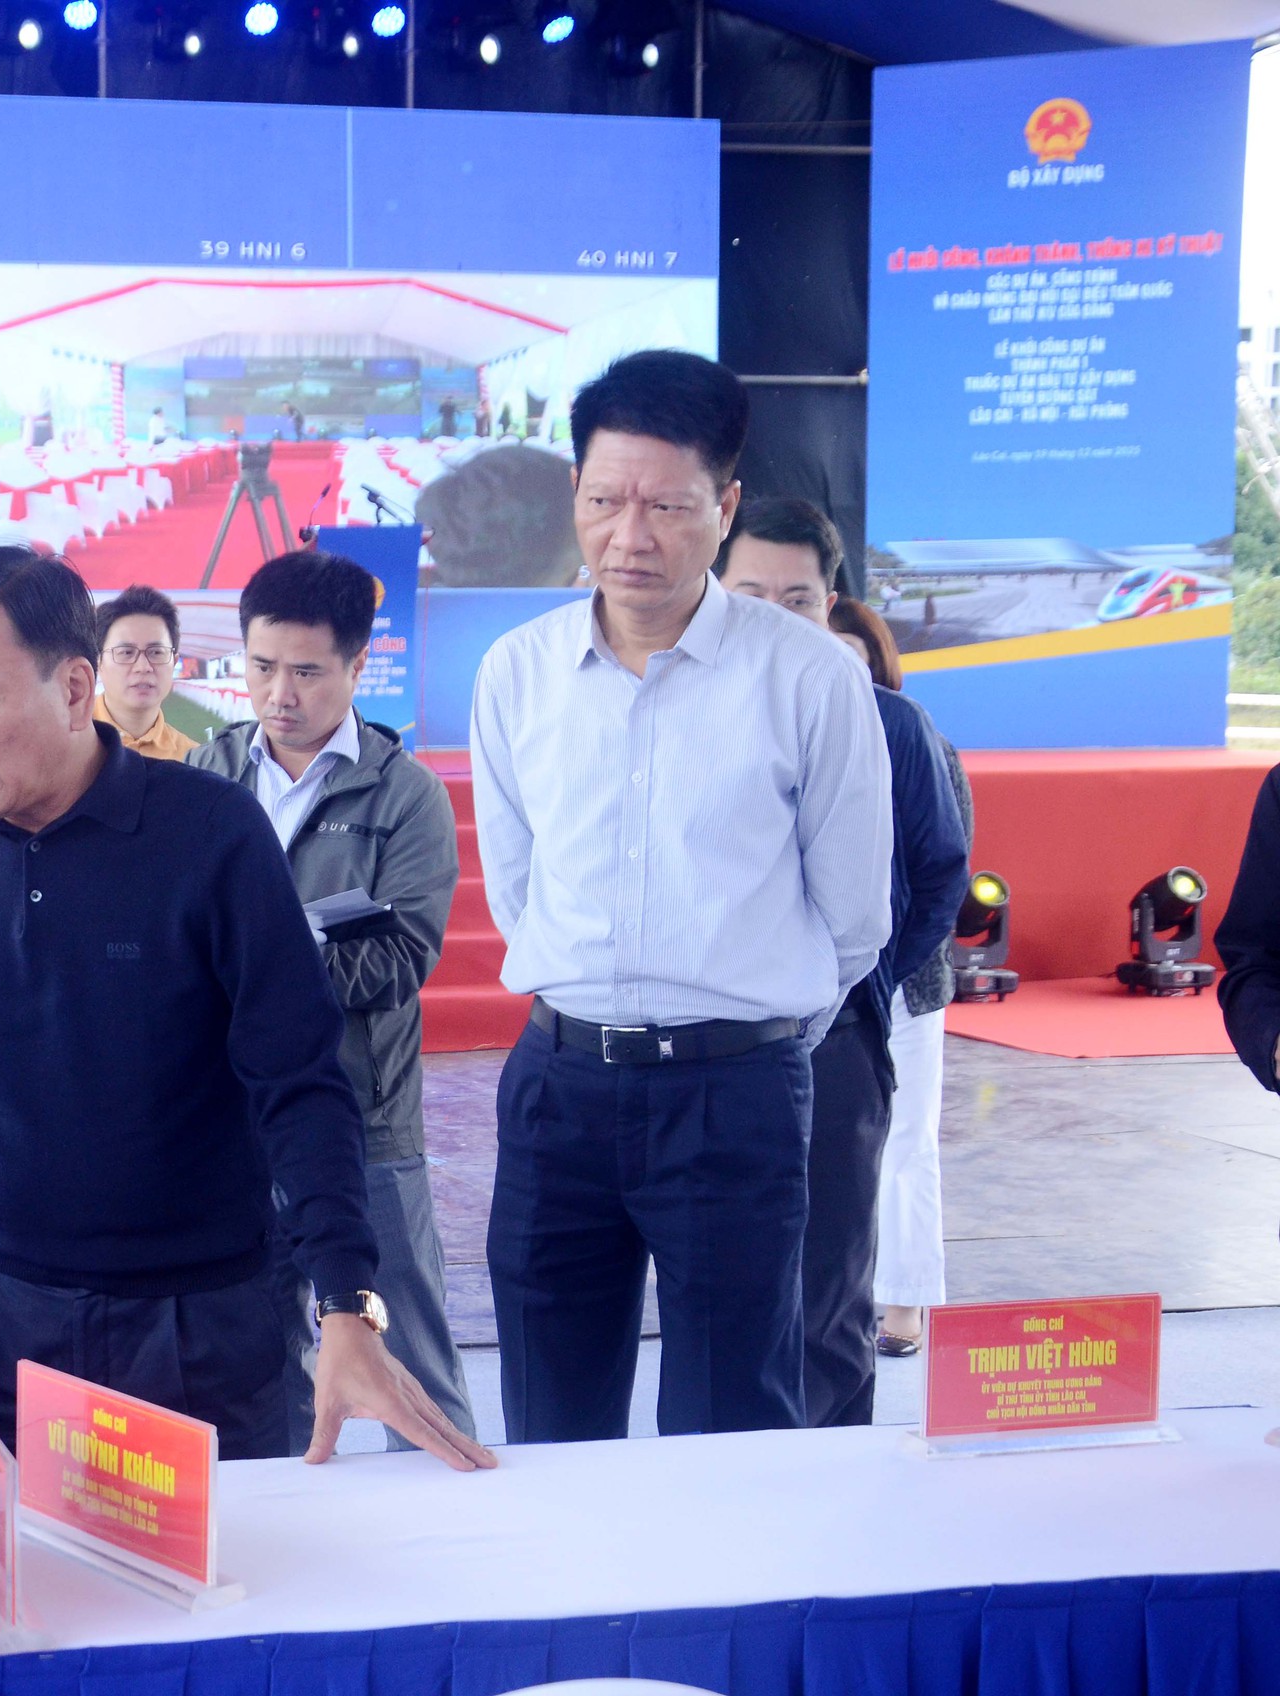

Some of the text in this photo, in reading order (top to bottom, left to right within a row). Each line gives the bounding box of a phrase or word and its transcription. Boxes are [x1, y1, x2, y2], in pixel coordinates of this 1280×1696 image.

[201, 240, 306, 260] 39 HNI 6
[577, 250, 678, 269] 40 HNI 7
[374, 633, 407, 652] CÔNG
[106, 942, 140, 953] BOSS
[1023, 1314, 1064, 1333] ĐỒNG CHÍ
[968, 1335, 1117, 1378] TRỊNH VIỆT HÙNG
[48, 1418, 175, 1498] VŨ QUỲNH KHÁNH
